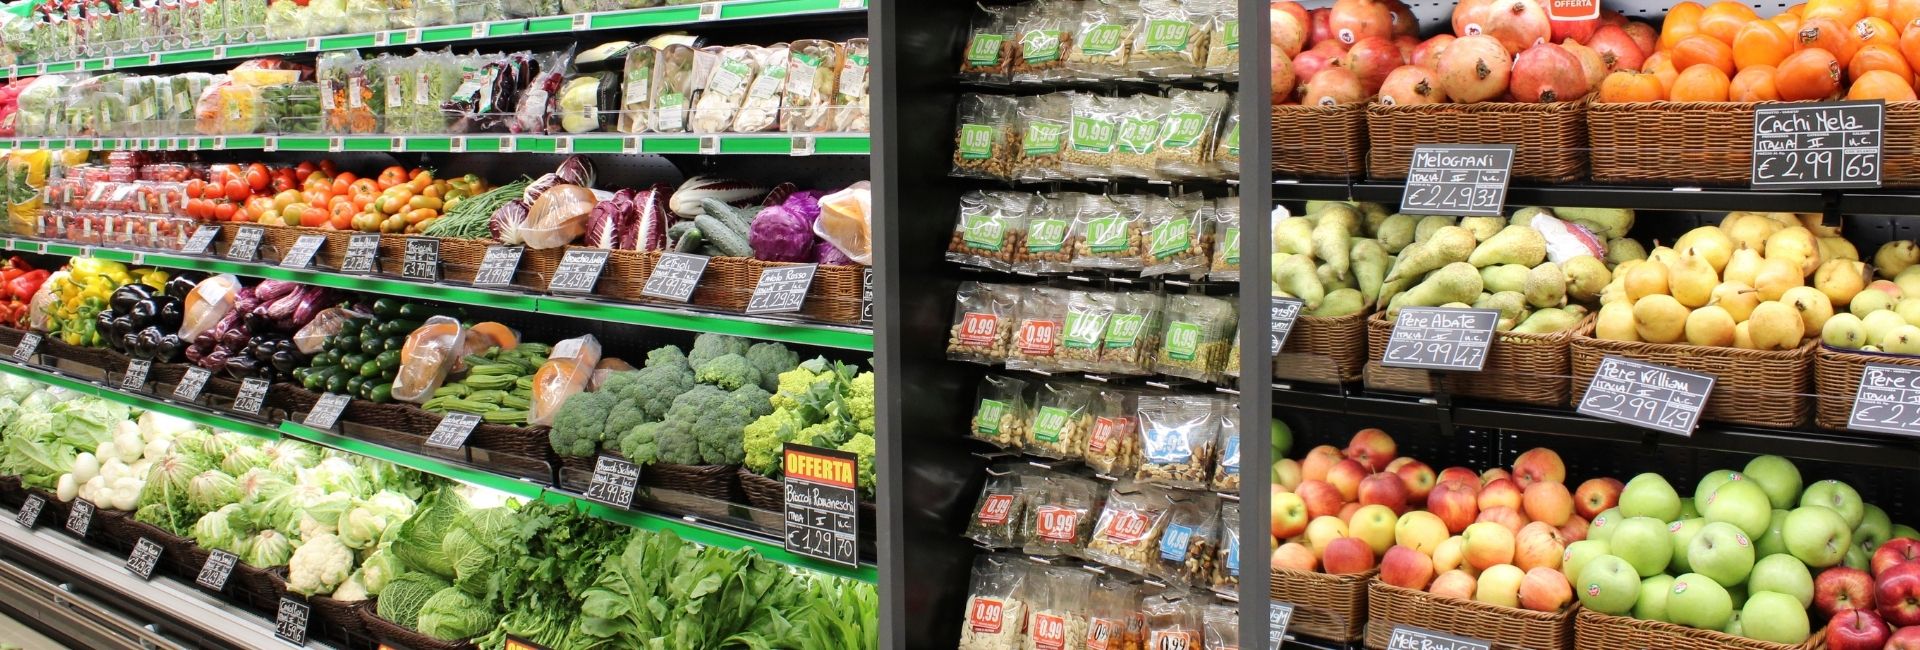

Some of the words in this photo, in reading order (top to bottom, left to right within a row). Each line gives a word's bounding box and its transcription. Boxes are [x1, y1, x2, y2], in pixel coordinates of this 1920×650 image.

[1554, 0, 1592, 8] OFFERTA
[1089, 28, 1119, 46] 0,99
[1154, 24, 1185, 42] 0,99
[975, 38, 1000, 55] 0,99
[1817, 109, 1865, 132] Mela
[966, 129, 991, 149] 0,99
[1076, 121, 1110, 142] 0,99
[1758, 139, 1798, 151] ITALIA
[1846, 155, 1876, 178] 65
[1472, 189, 1500, 207] 31
[966, 316, 995, 336] 0,99
[1400, 312, 1428, 328] Pere
[1025, 324, 1054, 345] 0,99
[1171, 327, 1197, 348] 0,99
[1454, 346, 1481, 365] 47
[1603, 362, 1636, 383] Pere
[1639, 370, 1689, 392] William
[1867, 370, 1906, 388] Pere
[1862, 391, 1896, 401] ITALIA
[983, 405, 1000, 422] 0,99
[1039, 412, 1062, 430] 0,99
[1660, 409, 1690, 428] 49
[1094, 422, 1112, 440] 0,99
[786, 452, 854, 484] OFFERTA
[616, 490, 630, 504] 33
[786, 484, 812, 506] Broccoli
[987, 498, 1011, 515] 0,99
[1044, 511, 1075, 533] 0,99
[1113, 515, 1145, 535] 0,99
[836, 537, 852, 558] 70
[1167, 529, 1189, 549] 0,99
[976, 602, 1001, 623] 0,99
[1039, 619, 1064, 641] 0,99
[1392, 633, 1420, 650] Mele
